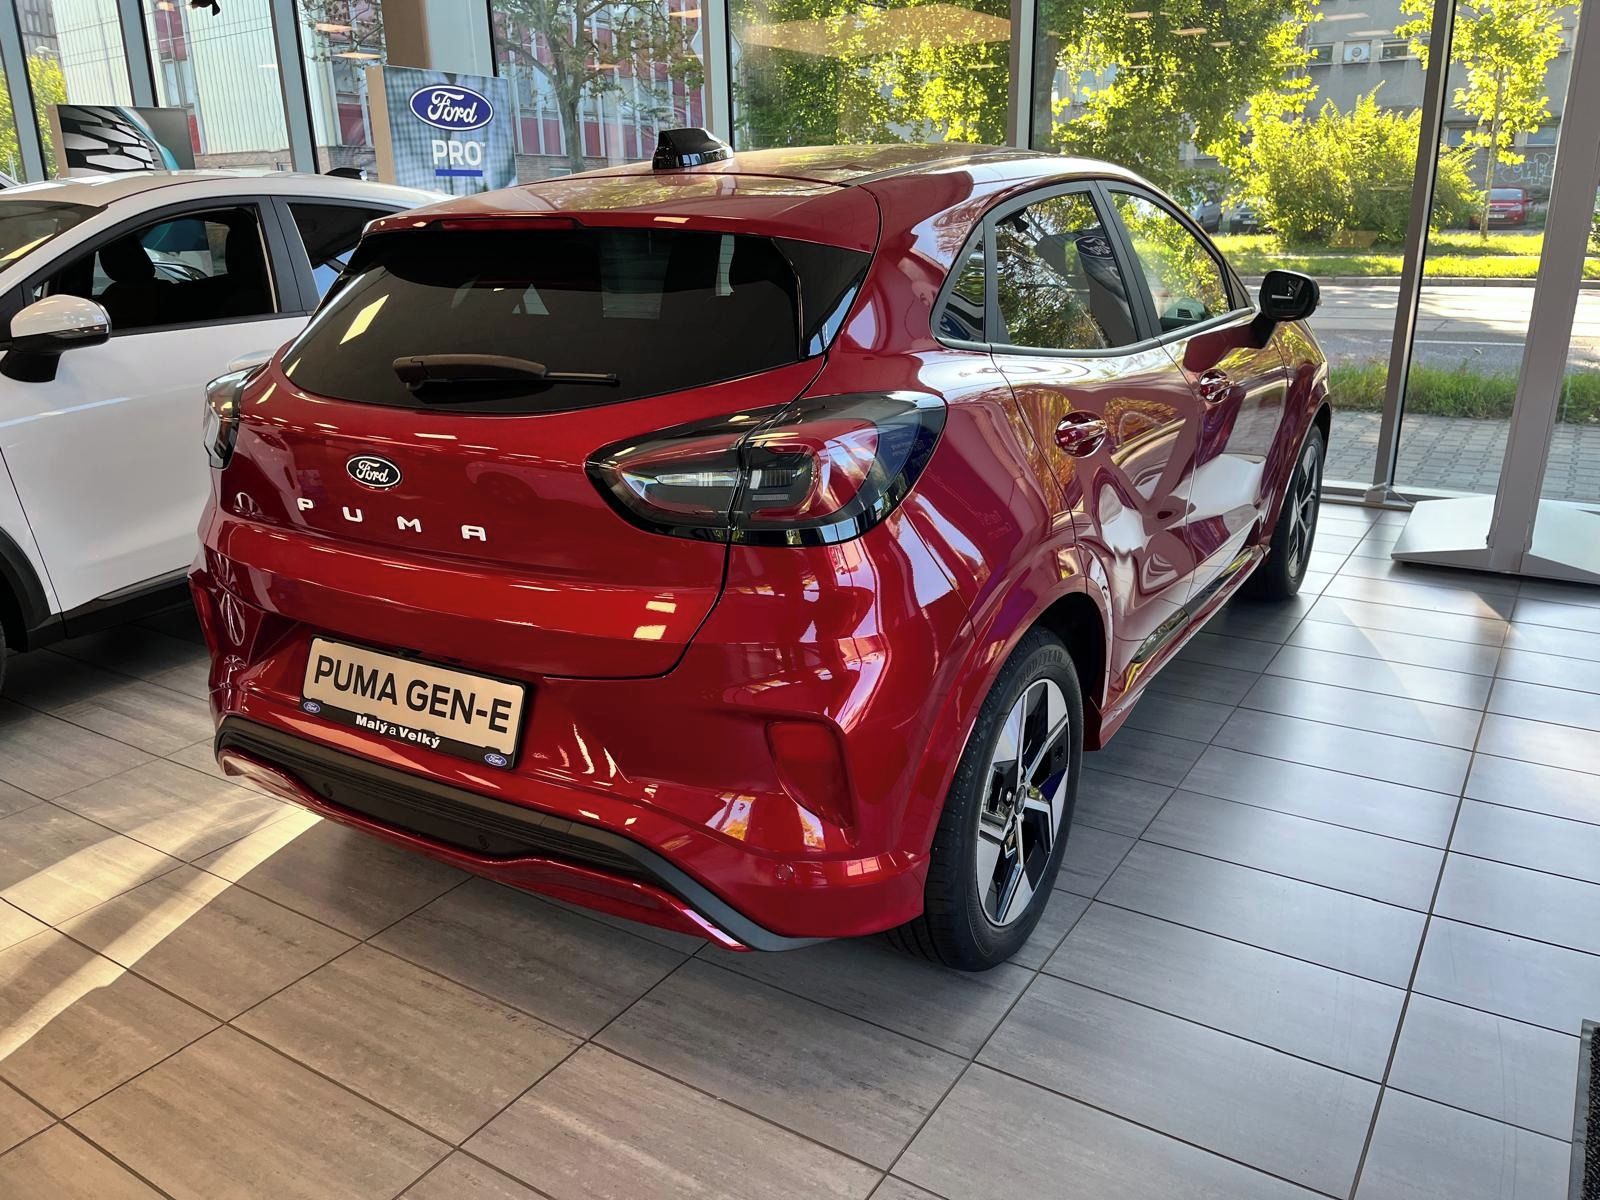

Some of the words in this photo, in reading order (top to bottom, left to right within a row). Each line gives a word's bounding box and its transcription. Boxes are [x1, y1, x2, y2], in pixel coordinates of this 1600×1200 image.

[427, 90, 478, 123] Ford
[356, 460, 389, 483] Ford
[297, 497, 487, 542] PUMA
[314, 655, 398, 706] PUMA
[406, 679, 512, 734] GEN-E
[356, 715, 388, 734] Malý
[389, 726, 396, 735] a
[399, 726, 441, 749] Velký
